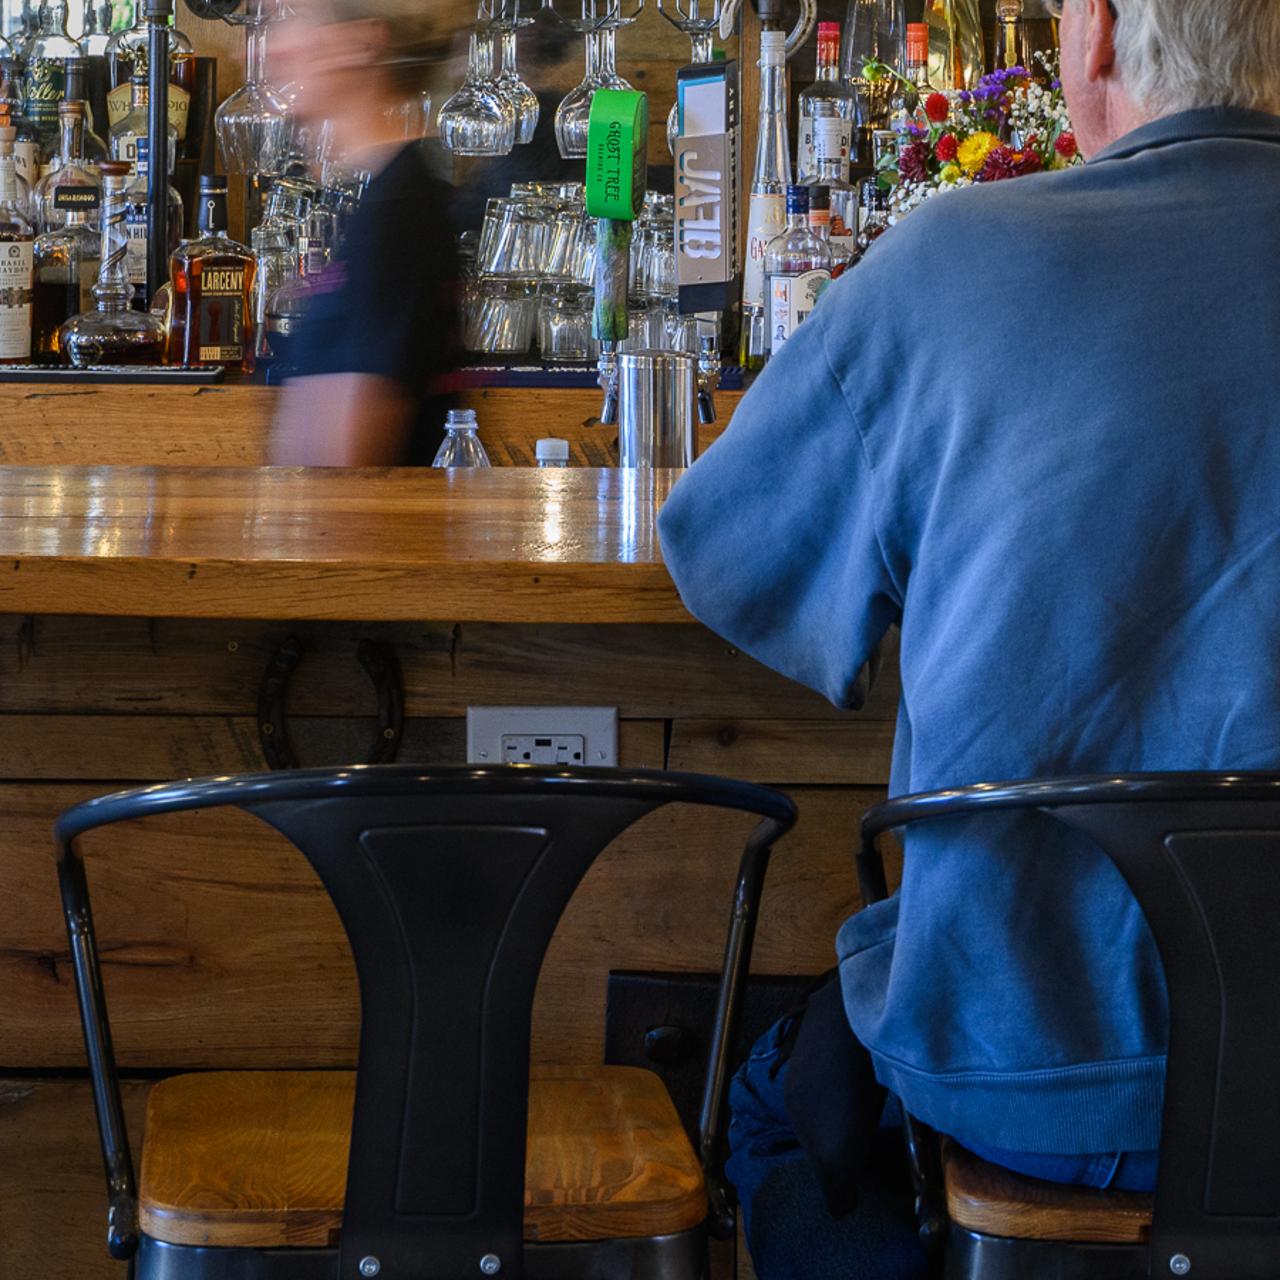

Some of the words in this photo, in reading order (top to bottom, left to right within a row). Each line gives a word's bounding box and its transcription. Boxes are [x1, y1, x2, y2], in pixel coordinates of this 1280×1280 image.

[606, 121, 622, 165] GHOST
[605, 166, 621, 203] TREE
[0, 259, 26, 267] BASIL
[201, 271, 244, 291] LARCENY
